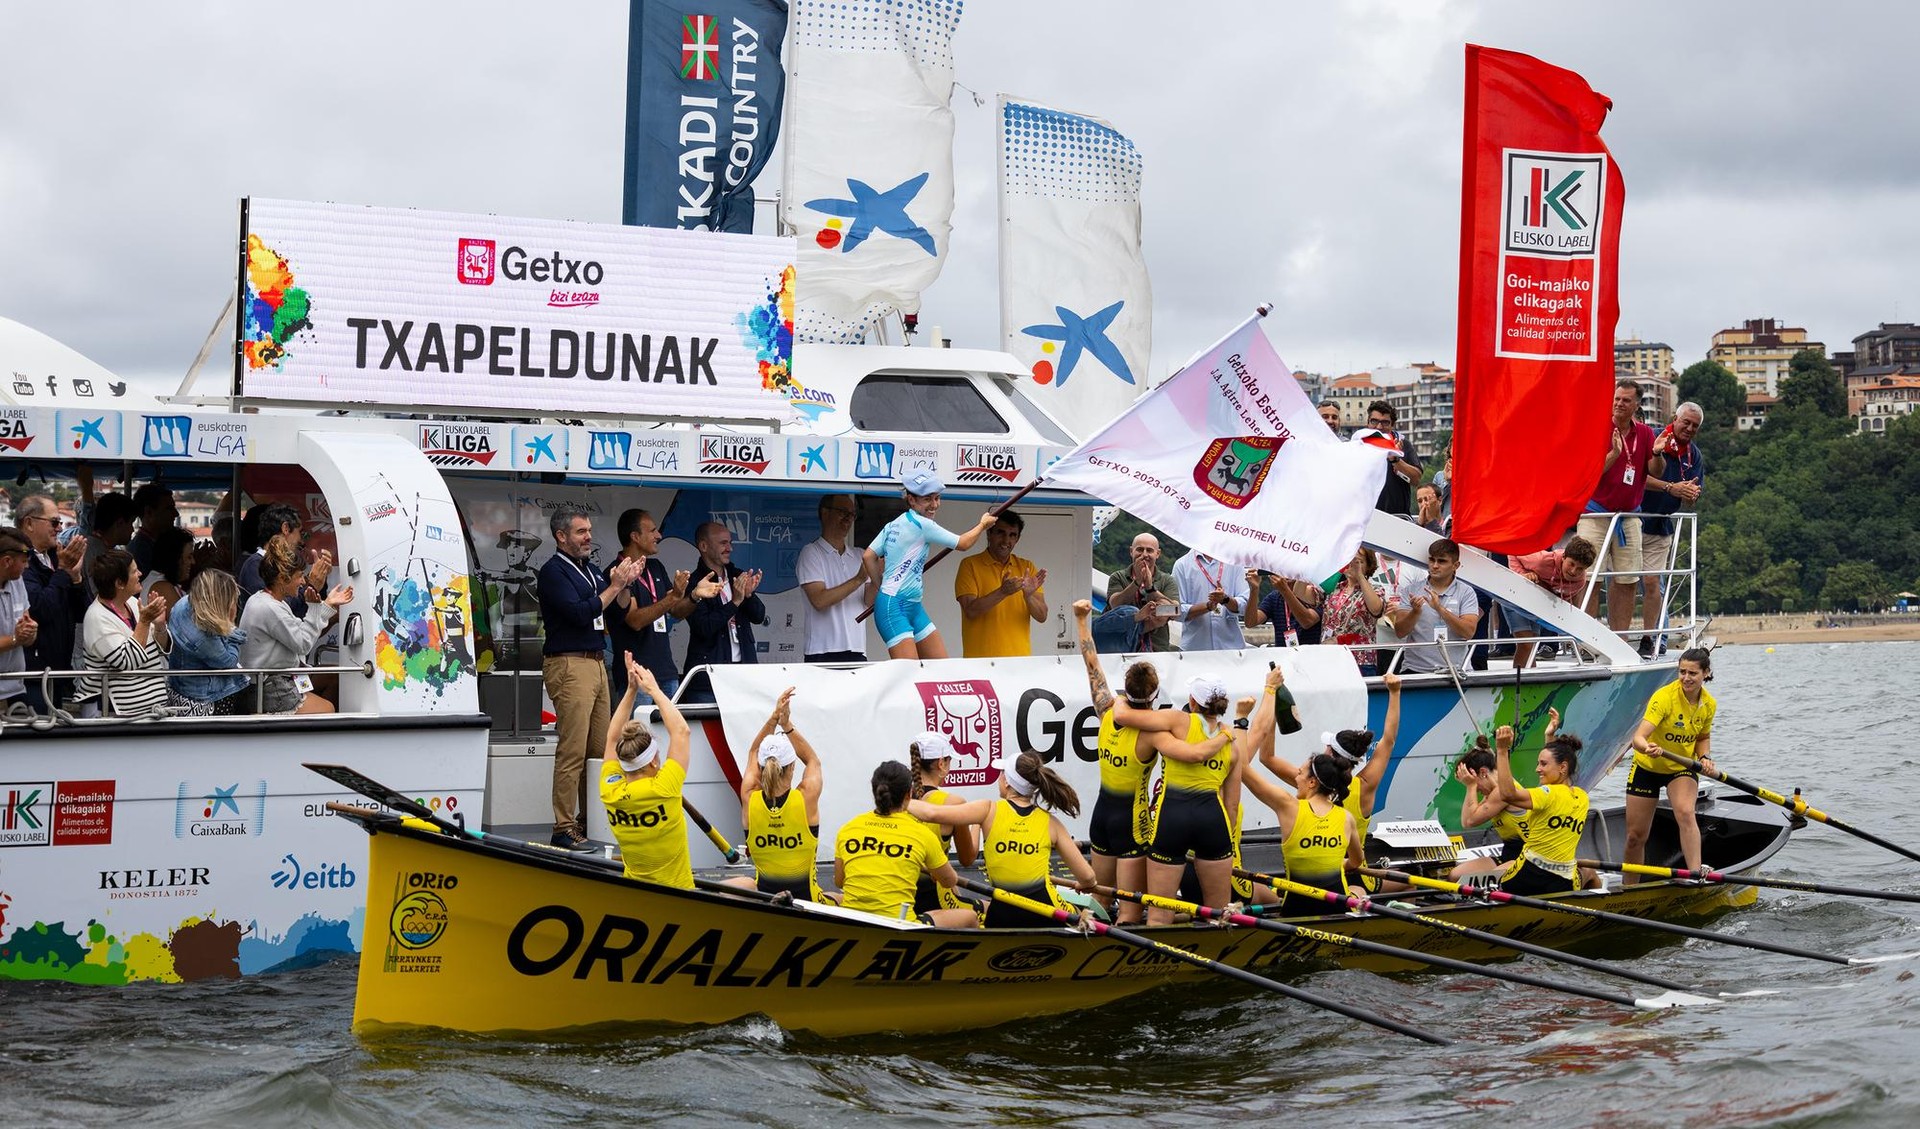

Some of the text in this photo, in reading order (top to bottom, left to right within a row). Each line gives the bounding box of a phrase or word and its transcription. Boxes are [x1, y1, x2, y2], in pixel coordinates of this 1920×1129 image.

[725, 17, 759, 187] COUNTRY
[677, 95, 718, 231] KADI
[1514, 231, 1590, 248] EUSKO LABEL
[501, 246, 604, 286] Getxo
[550, 289, 569, 302] bizi
[1514, 293, 1583, 314] elikagaak
[1515, 313, 1579, 327] Alimentos de
[1507, 326, 1586, 341] calidad superior
[347, 318, 720, 386] TXAPELDUNAK
[13, 372, 28, 381] You
[1227, 353, 1260, 396] Getxoko
[13, 382, 34, 395] Tube
[791, 386, 836, 404] e.com
[1210, 368, 1223, 384] J.A.
[1220, 382, 1242, 411] Agirre
[4, 410, 27, 419] LABEL
[0, 419, 27, 438] GA
[198, 422, 247, 433] euskotren
[445, 425, 491, 435] EUSKO LABEL
[198, 435, 247, 457] LIGA
[445, 435, 491, 453] LIGA
[636, 438, 679, 449] euskotren
[723, 436, 765, 446] EUSKO LABEL
[723, 445, 765, 462] LIGA
[899, 449, 938, 458] euskotren
[978, 444, 1017, 455] EUSKO LABEL
[1202, 441, 1224, 468] LEPOAN
[636, 451, 679, 471] LIGA
[978, 454, 1016, 470] LIGA
[1088, 455, 1191, 510] GETXO, 2023-07-29
[374, 503, 393, 513] LIGA
[755, 515, 793, 524] euskotren
[756, 525, 792, 543] LIGA
[1214, 521, 1310, 555] EUSKOTREN LIGA
[937, 683, 974, 694] KALTEA
[58, 793, 113, 804] Goi-mailako
[61, 804, 106, 816] elikagaiak
[304, 799, 390, 817] eustren
[607, 804, 668, 828] ORIO!
[62, 817, 104, 827] Alimentos de
[190, 823, 247, 837] CaixaBank
[0, 832, 46, 843] USKO LABEL
[57, 827, 108, 836] calidad superior
[755, 833, 803, 849] ORIO!
[845, 836, 913, 859] ORIO!
[995, 841, 1039, 855] ORIO!
[1300, 835, 1342, 849] ORIO!
[98, 867, 211, 890] KELER
[303, 862, 356, 889] eitb
[110, 889, 199, 900] DONOSTIA 1872
[1296, 926, 1353, 946] SAGARDI
[507, 904, 860, 988] ORIALKI
[1001, 949, 1056, 969] Ford
